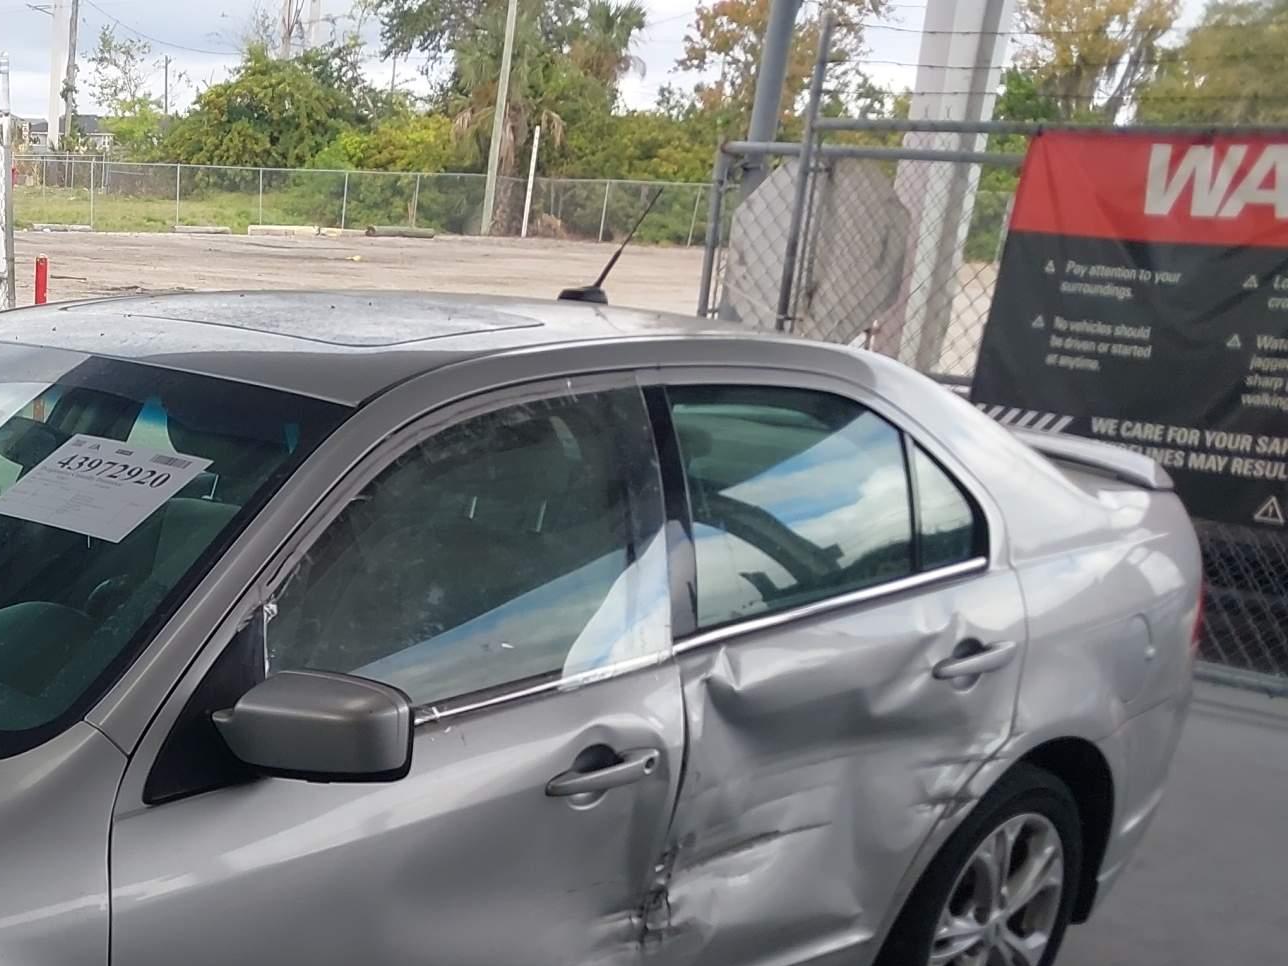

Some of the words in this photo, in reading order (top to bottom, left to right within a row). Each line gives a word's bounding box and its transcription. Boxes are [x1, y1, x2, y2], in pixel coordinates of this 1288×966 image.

[1144, 143, 1288, 219] WA
[1065, 260, 1088, 277] Pay
[1089, 264, 1137, 280] attention
[1138, 269, 1152, 281] to
[1154, 272, 1182, 285] your
[1069, 320, 1112, 336] vehicles
[1114, 324, 1152, 339] should
[1063, 336, 1096, 351] driven
[1098, 342, 1109, 353] or
[1110, 343, 1152, 358] started
[1091, 416, 1118, 436] WE
[1120, 420, 1165, 442] CARE
[1166, 426, 1200, 446] FOR
[1204, 430, 1253, 451] YOUR
[57, 454, 171, 488] 43972920
[1188, 452, 1229, 473] MAY
